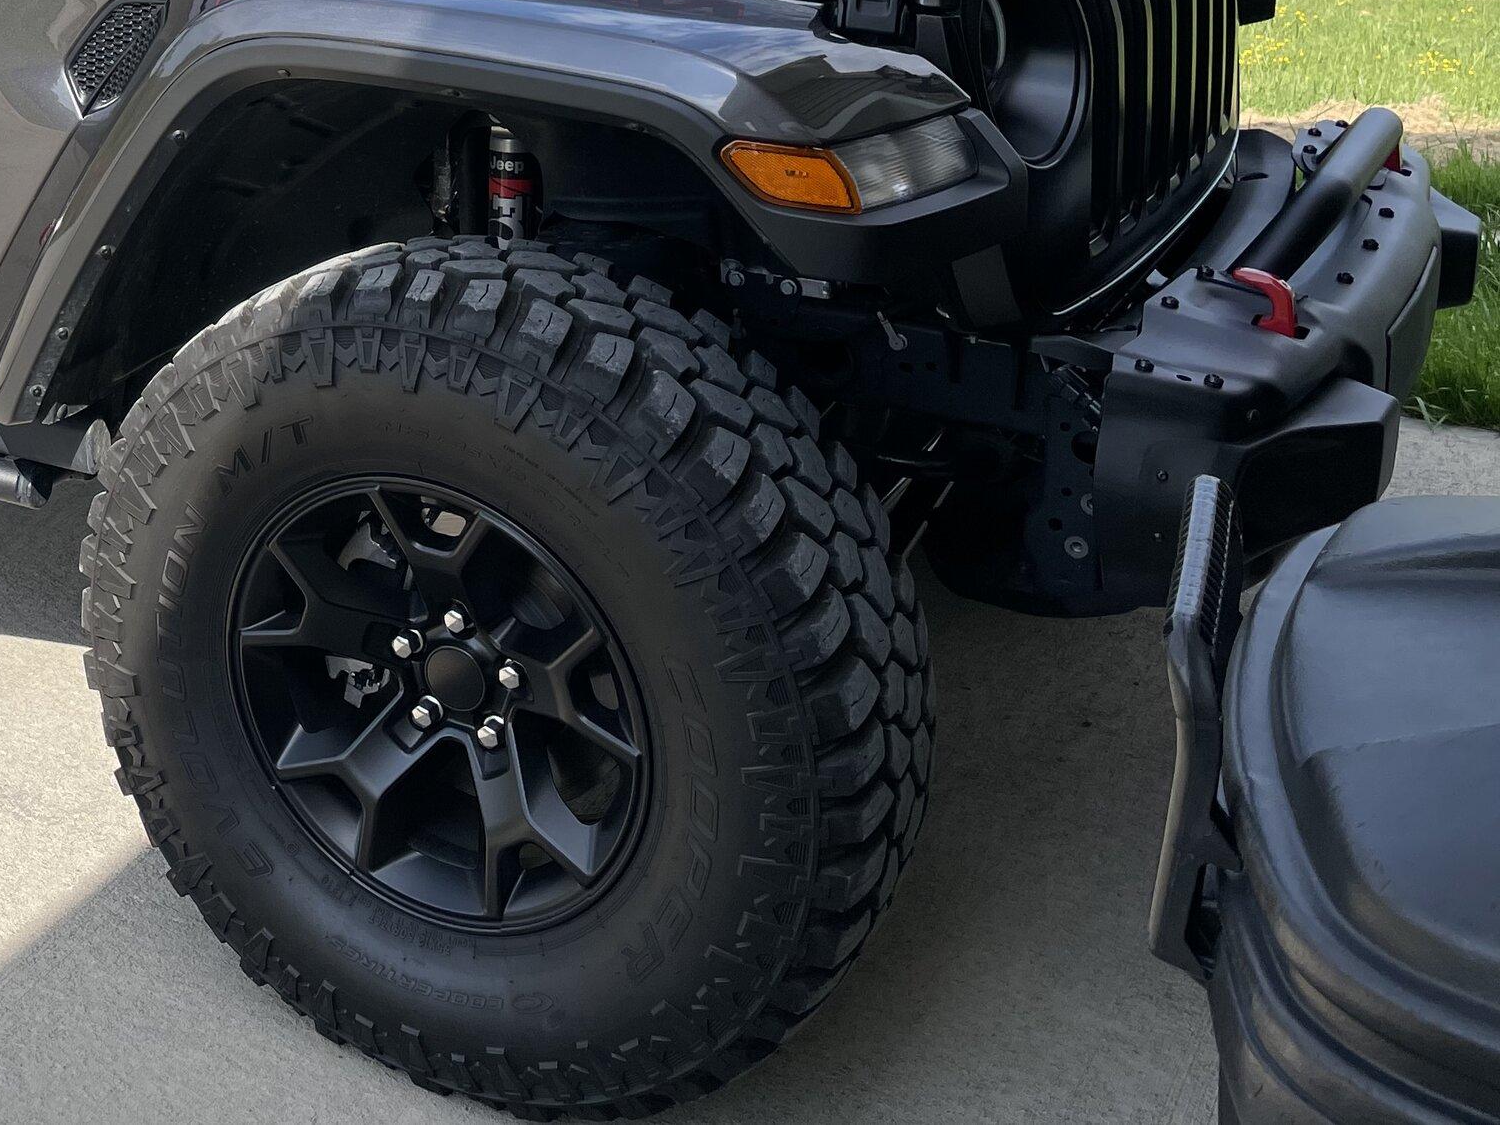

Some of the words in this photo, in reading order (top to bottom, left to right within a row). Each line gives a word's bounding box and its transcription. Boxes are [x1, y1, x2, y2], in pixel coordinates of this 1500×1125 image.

[490, 156, 524, 173] Jeep
[154, 499, 274, 877] EVOLUTION
[215, 414, 314, 494] M/T
